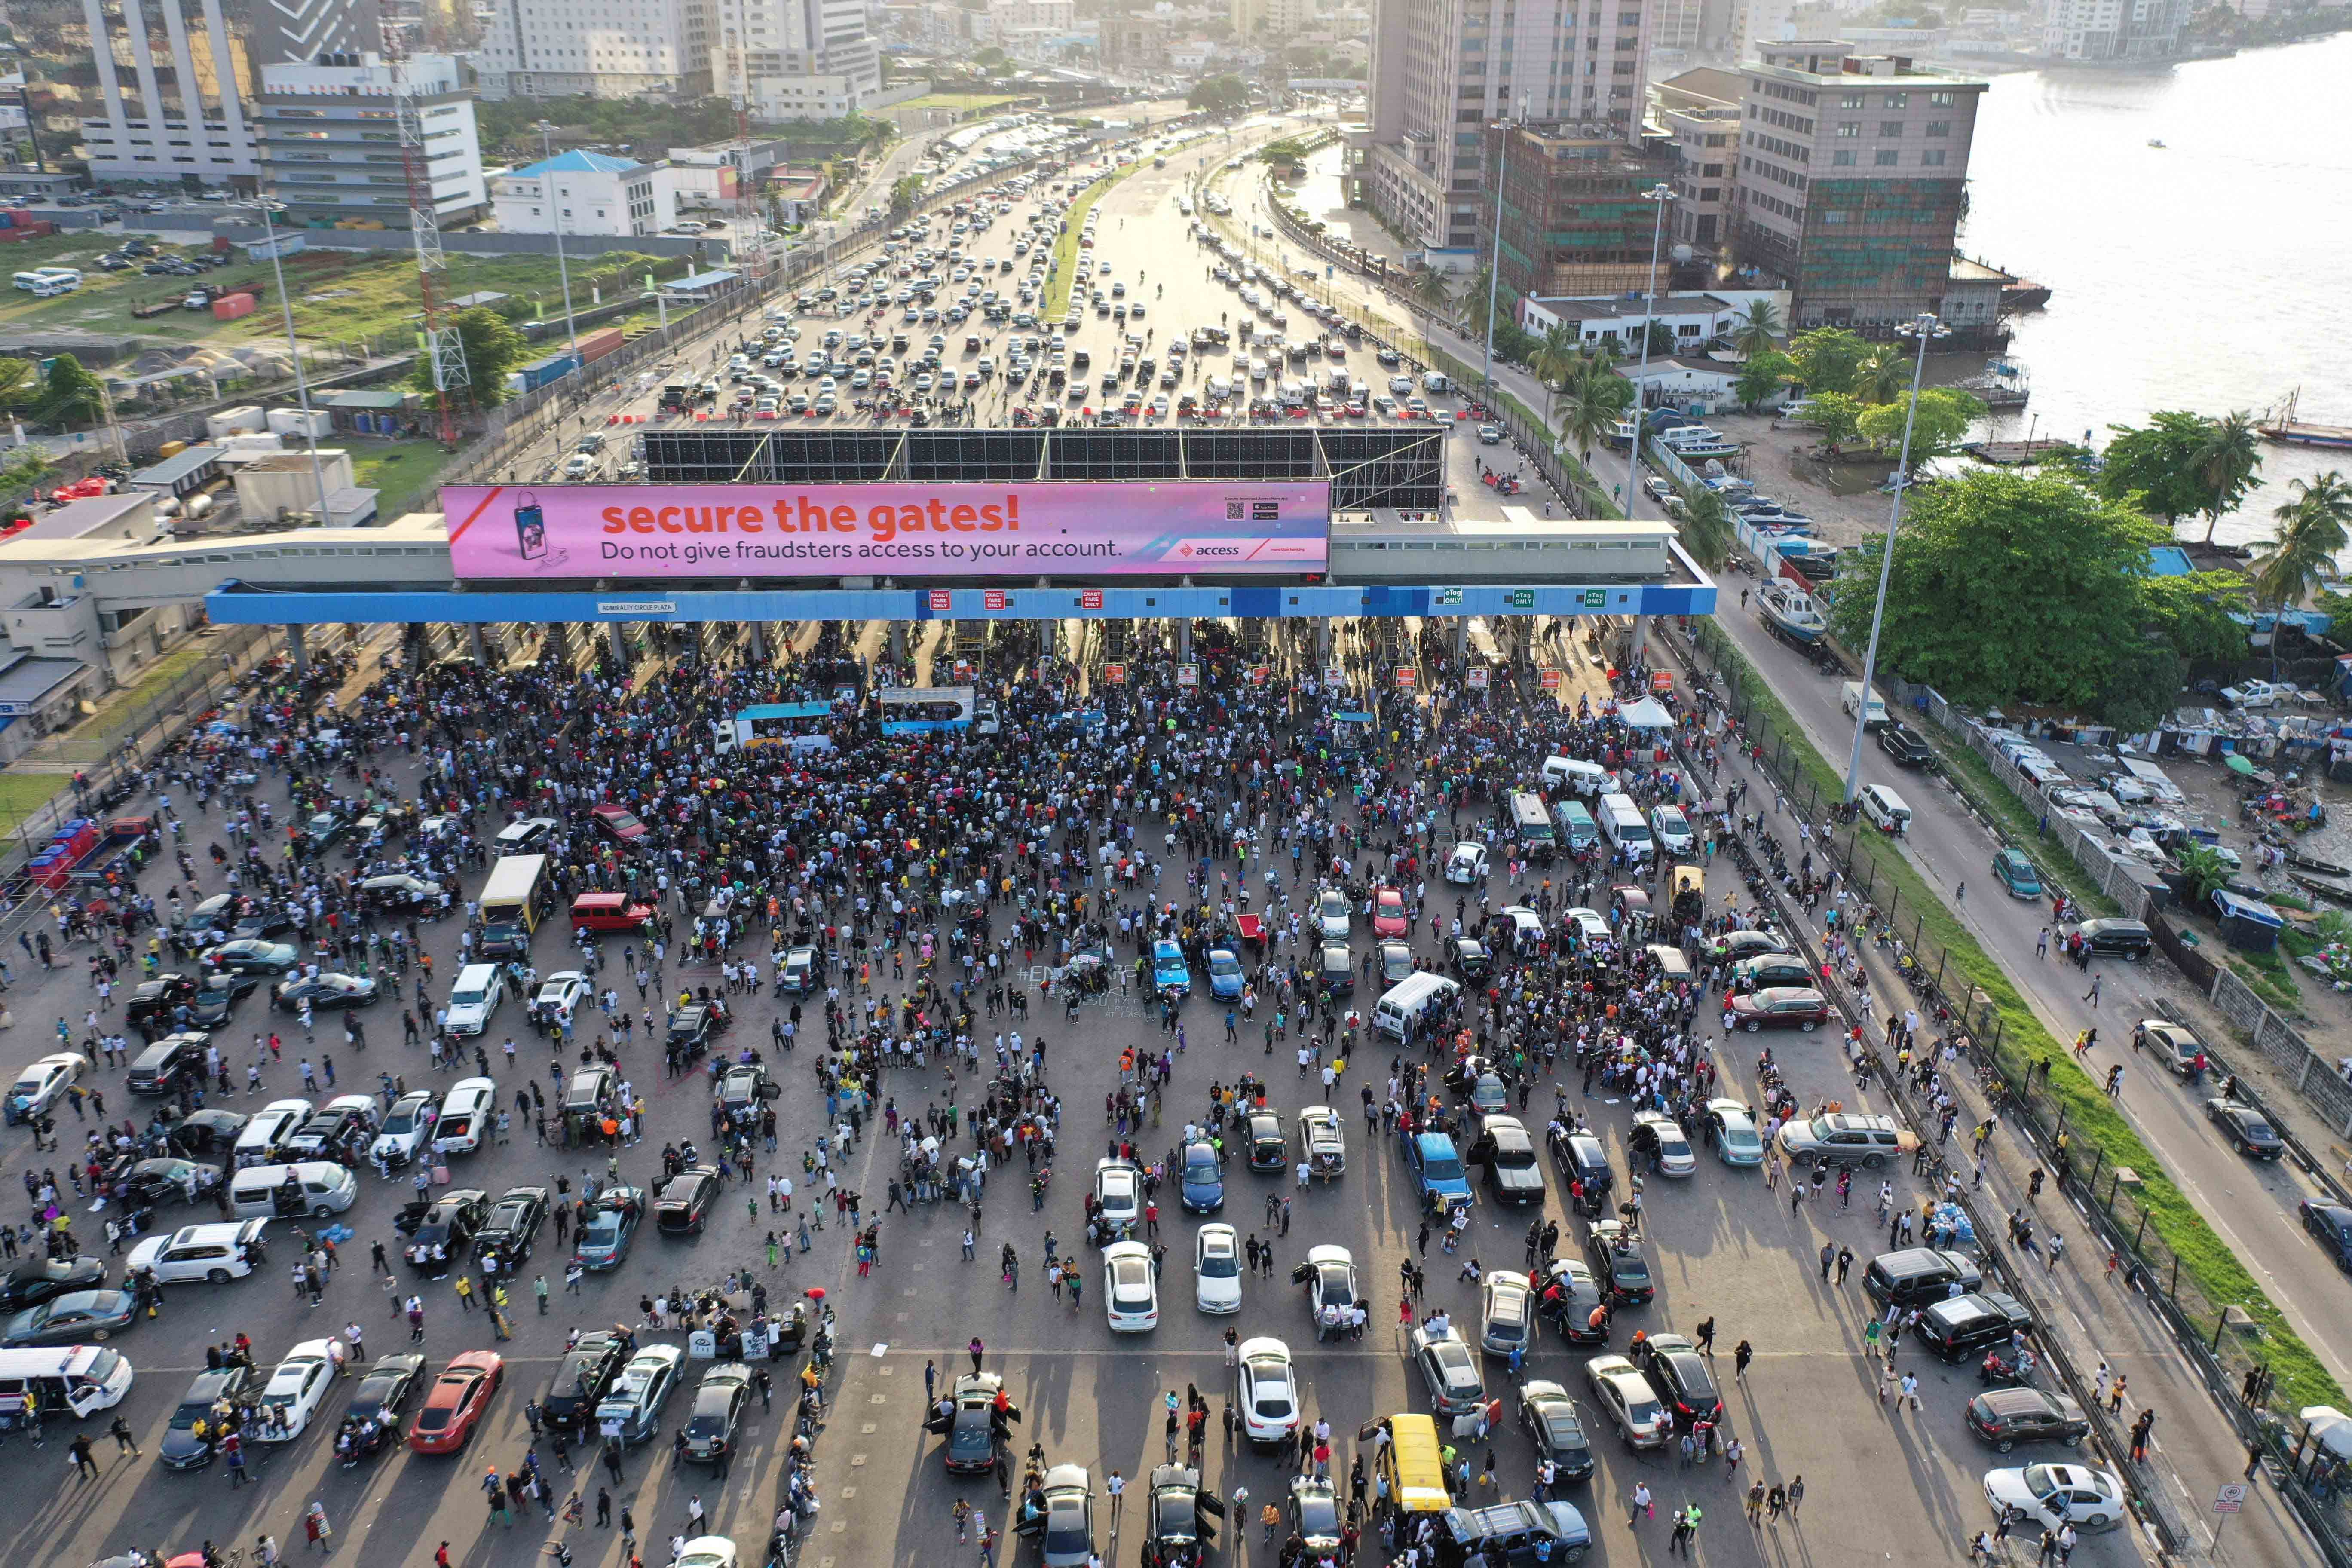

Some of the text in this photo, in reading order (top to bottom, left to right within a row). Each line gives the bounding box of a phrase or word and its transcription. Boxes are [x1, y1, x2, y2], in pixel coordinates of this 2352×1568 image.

[602, 495, 1018, 541] secure the gates!
[601, 539, 1122, 564] Do not give fraudsters access to your account.
[1196, 547, 1239, 555] access
